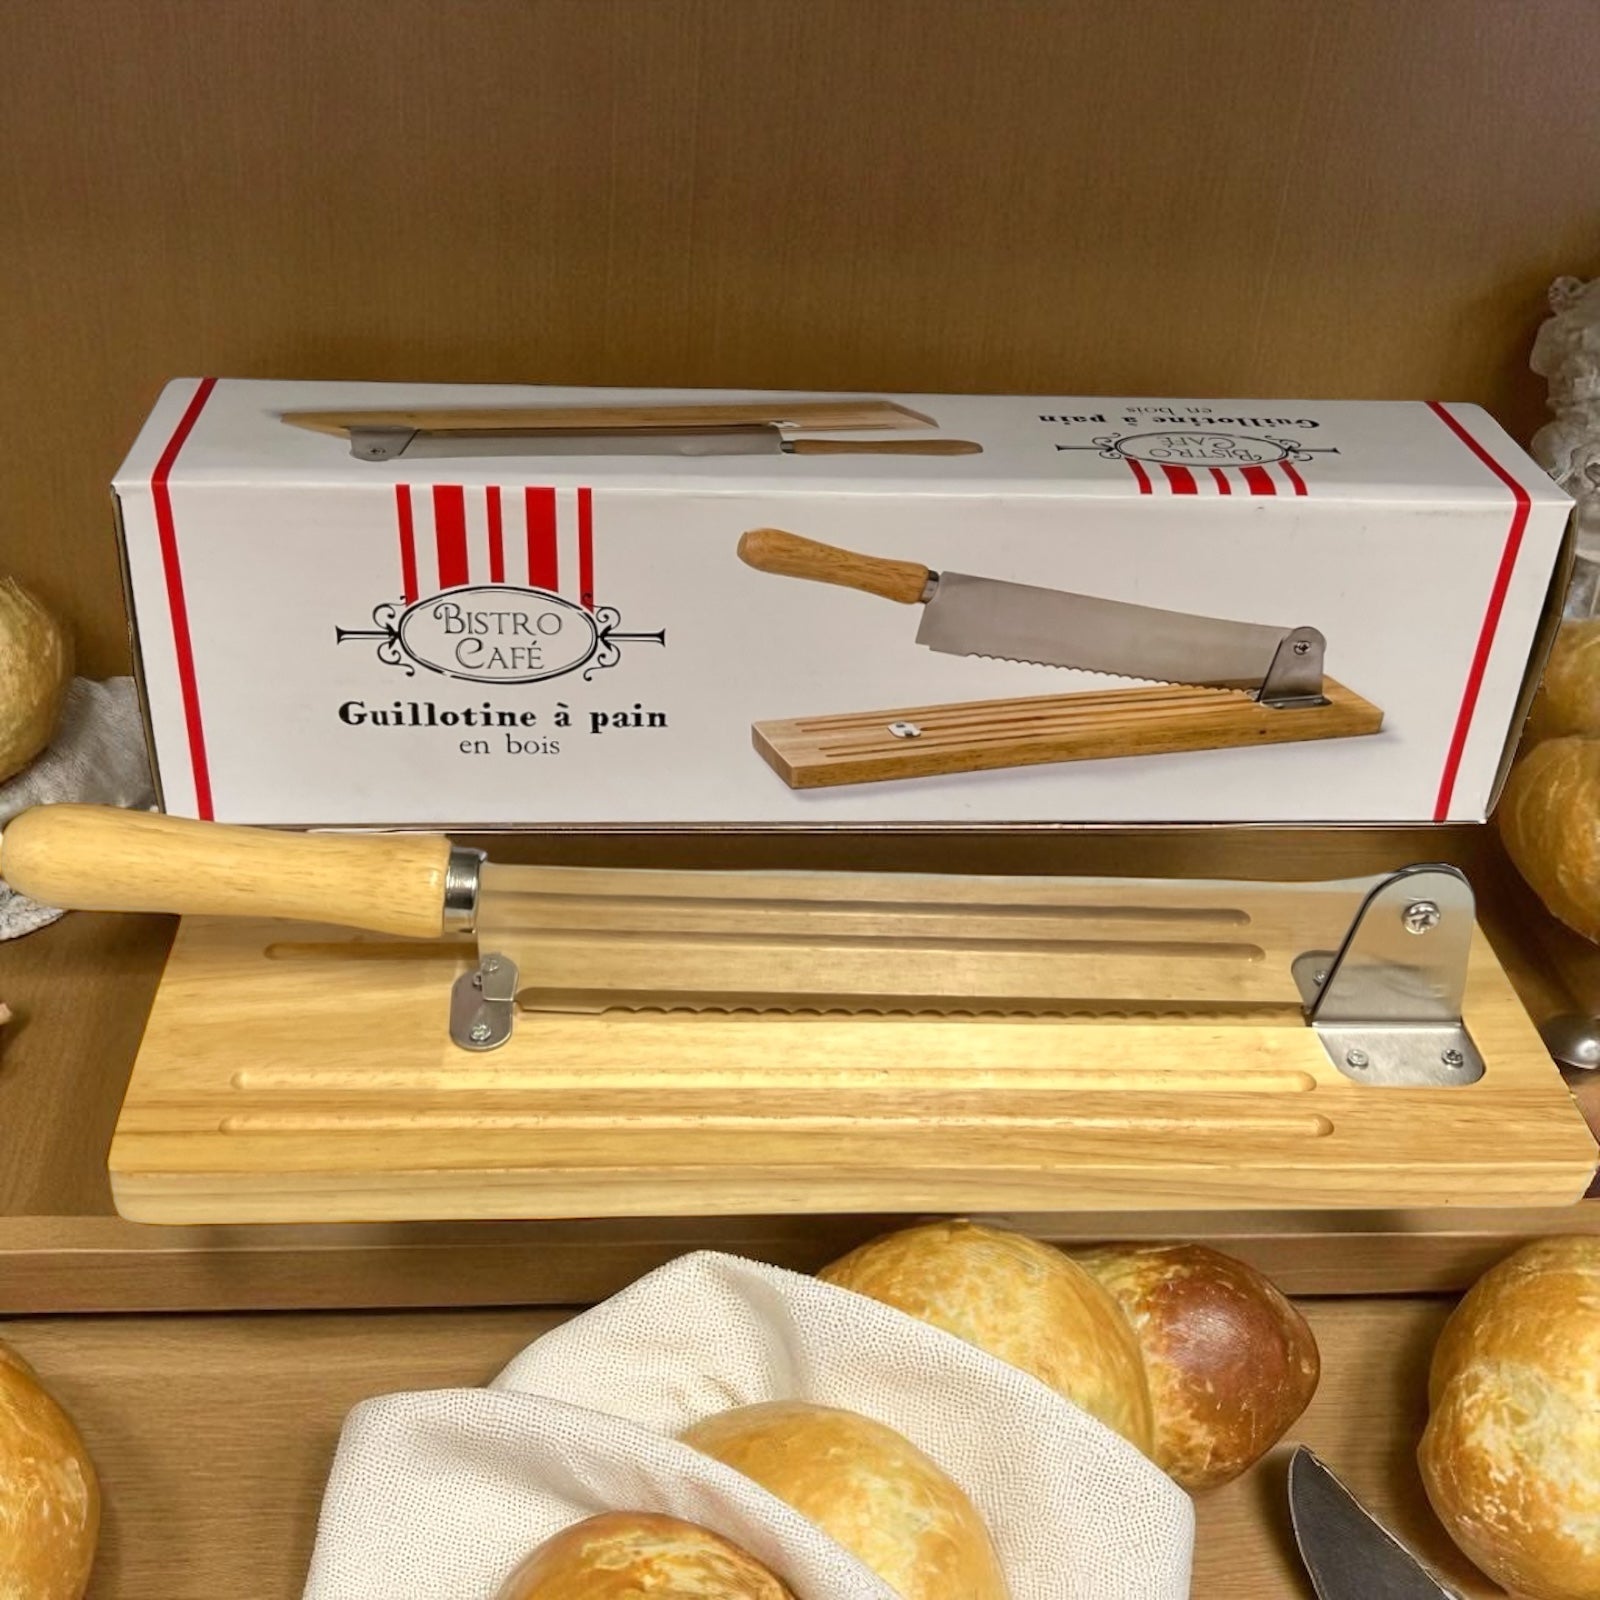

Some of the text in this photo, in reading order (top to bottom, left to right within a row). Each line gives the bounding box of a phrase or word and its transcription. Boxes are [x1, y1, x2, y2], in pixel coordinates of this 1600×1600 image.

[1125, 406, 1174, 415] bois
[1039, 414, 1320, 429] Guillotine à pain
[1160, 436, 1236, 449] CAFÉ
[1149, 448, 1262, 461] BISTRO
[433, 602, 563, 636] BISTRO
[455, 637, 544, 670] CAFÉ
[338, 701, 668, 733] Guillotine à pain
[459, 733, 560, 754] en bois
